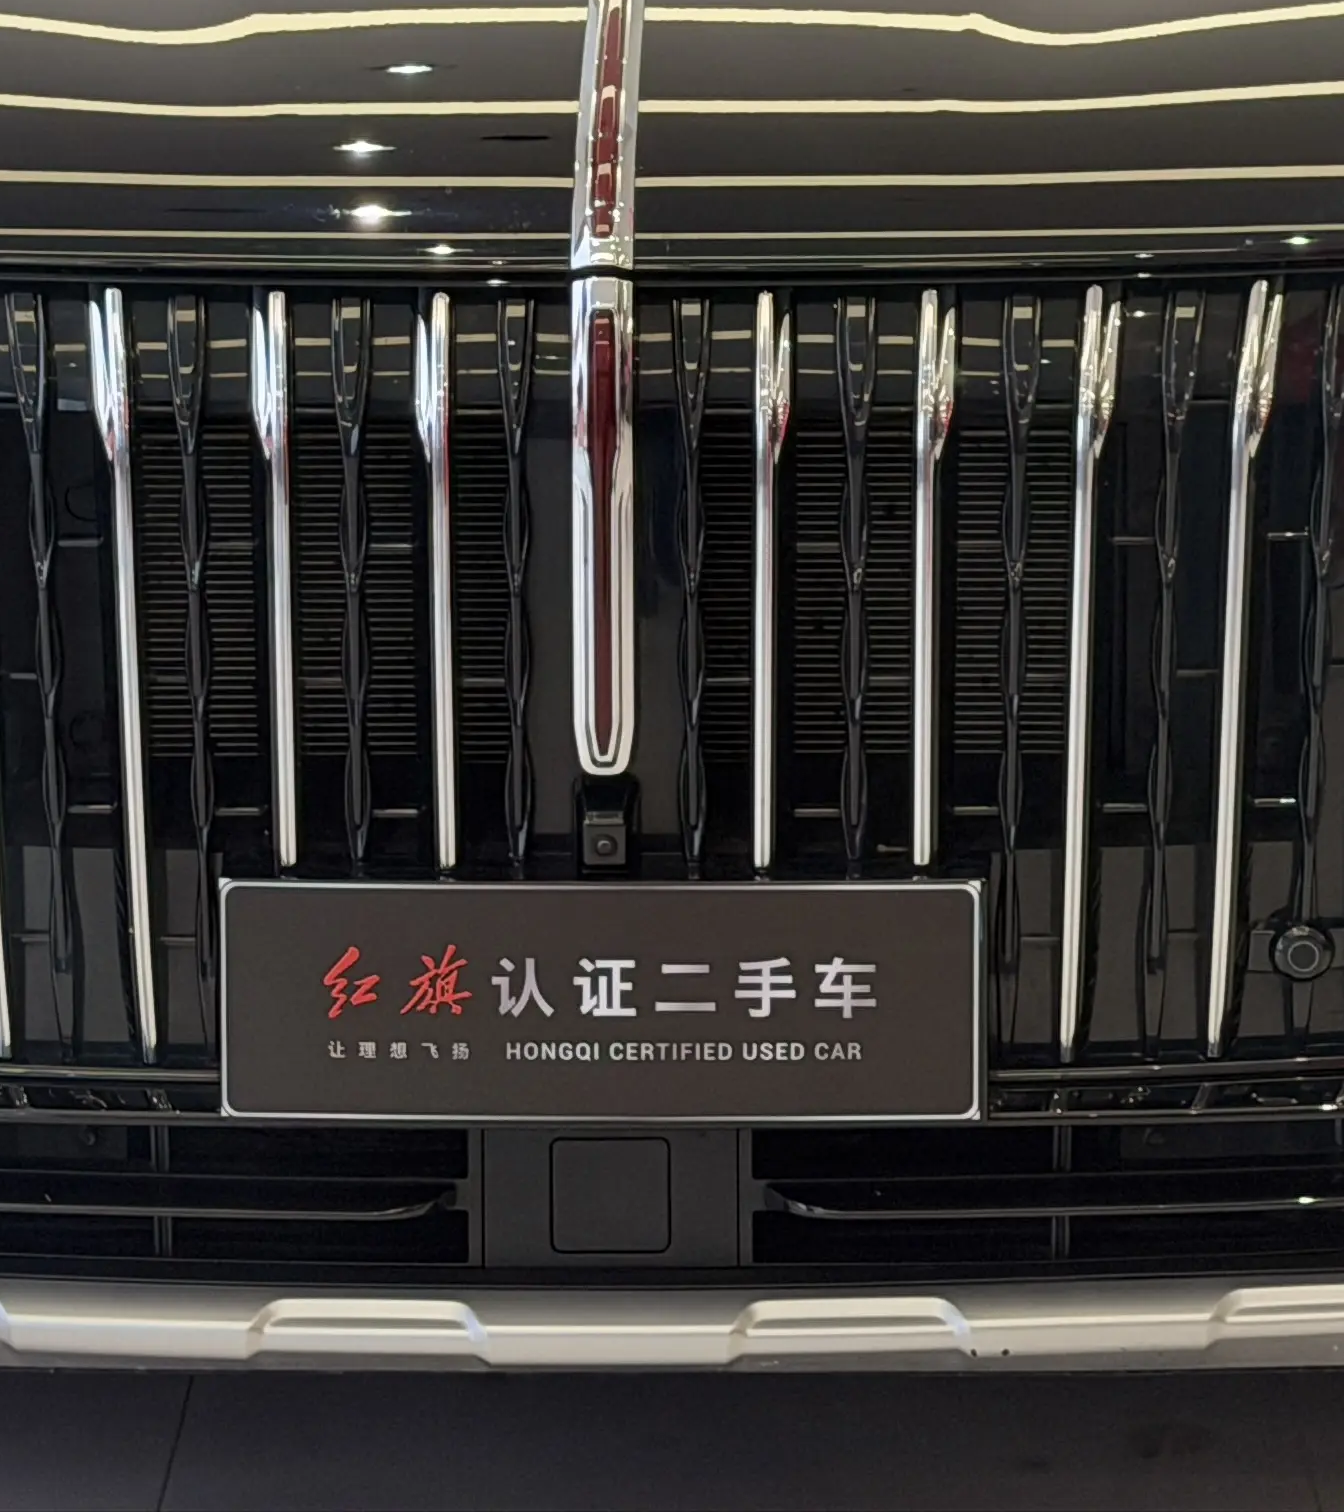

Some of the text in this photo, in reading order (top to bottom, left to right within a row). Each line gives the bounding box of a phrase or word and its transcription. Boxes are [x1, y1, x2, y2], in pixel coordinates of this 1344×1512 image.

[327, 1040, 471, 1061] 让理想飞扬
[506, 1042, 863, 1062] HONGQI CERTIFIED USED CAR
